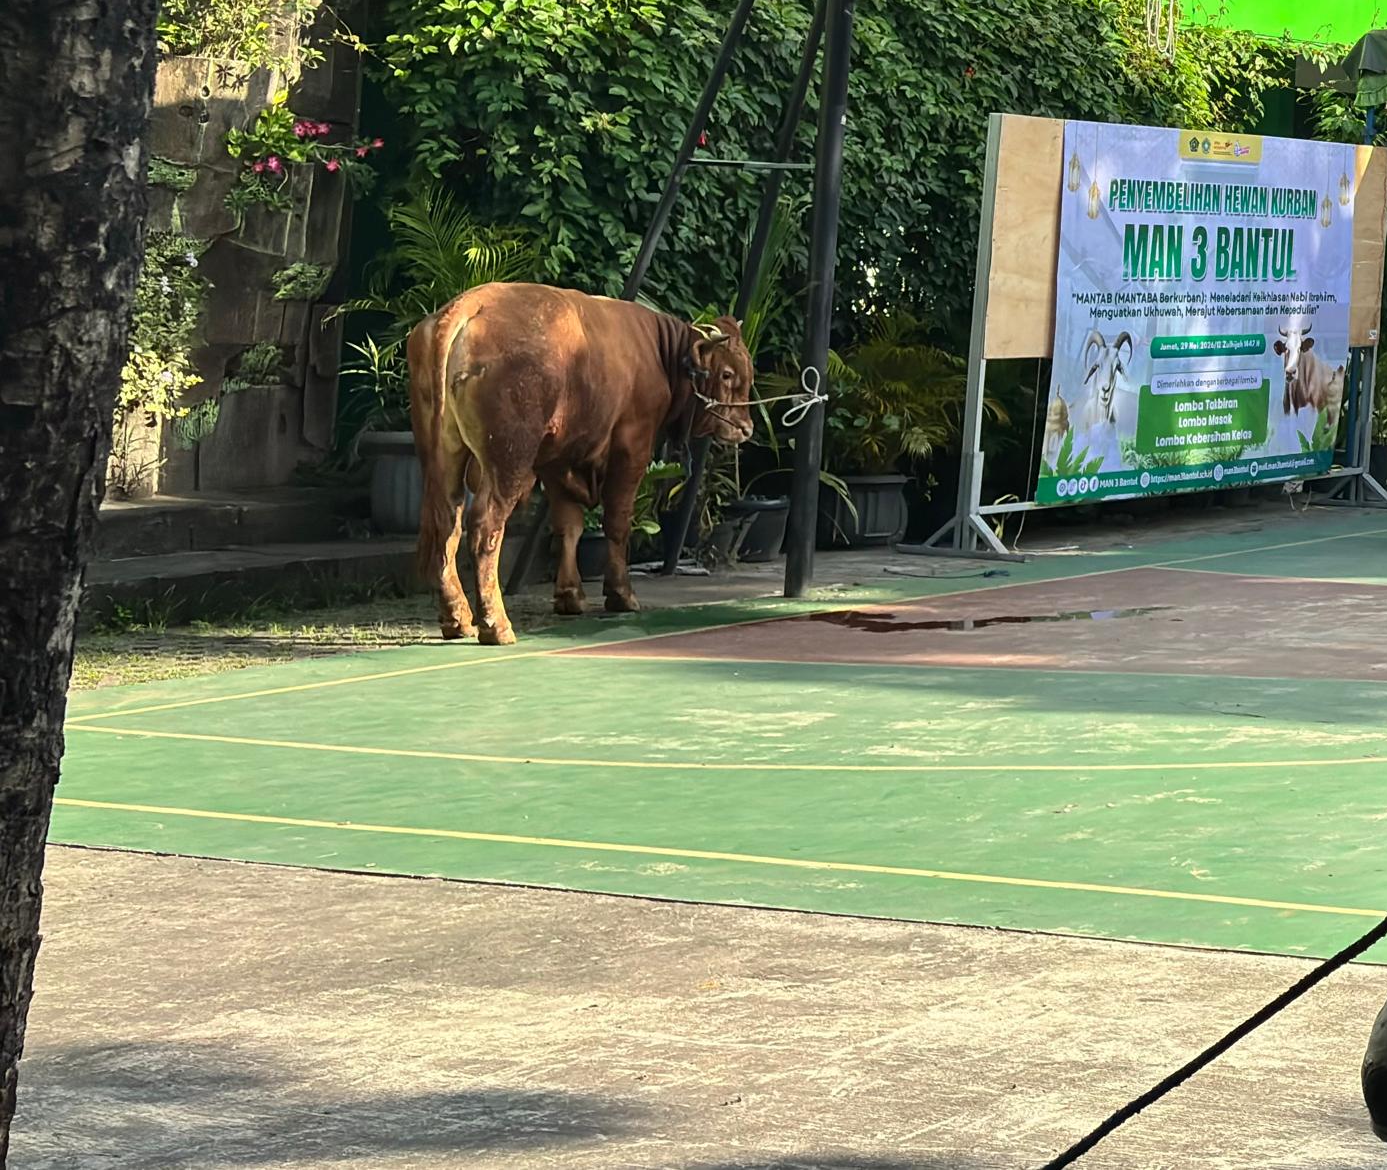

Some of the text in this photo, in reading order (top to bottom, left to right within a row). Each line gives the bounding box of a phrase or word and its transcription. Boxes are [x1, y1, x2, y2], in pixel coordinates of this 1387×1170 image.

[1109, 178, 1317, 219] PENYEMBELIHAN HEWAN KURBAN
[1123, 223, 1298, 281] MAN 3 BANTUL
[1089, 306, 1142, 321] Menguatkan
[1174, 397, 1238, 412] Lomba Takbiran
[1178, 413, 1233, 428] Lomba Masak
[1155, 429, 1252, 447] Lomba Kebersihan Kelas
